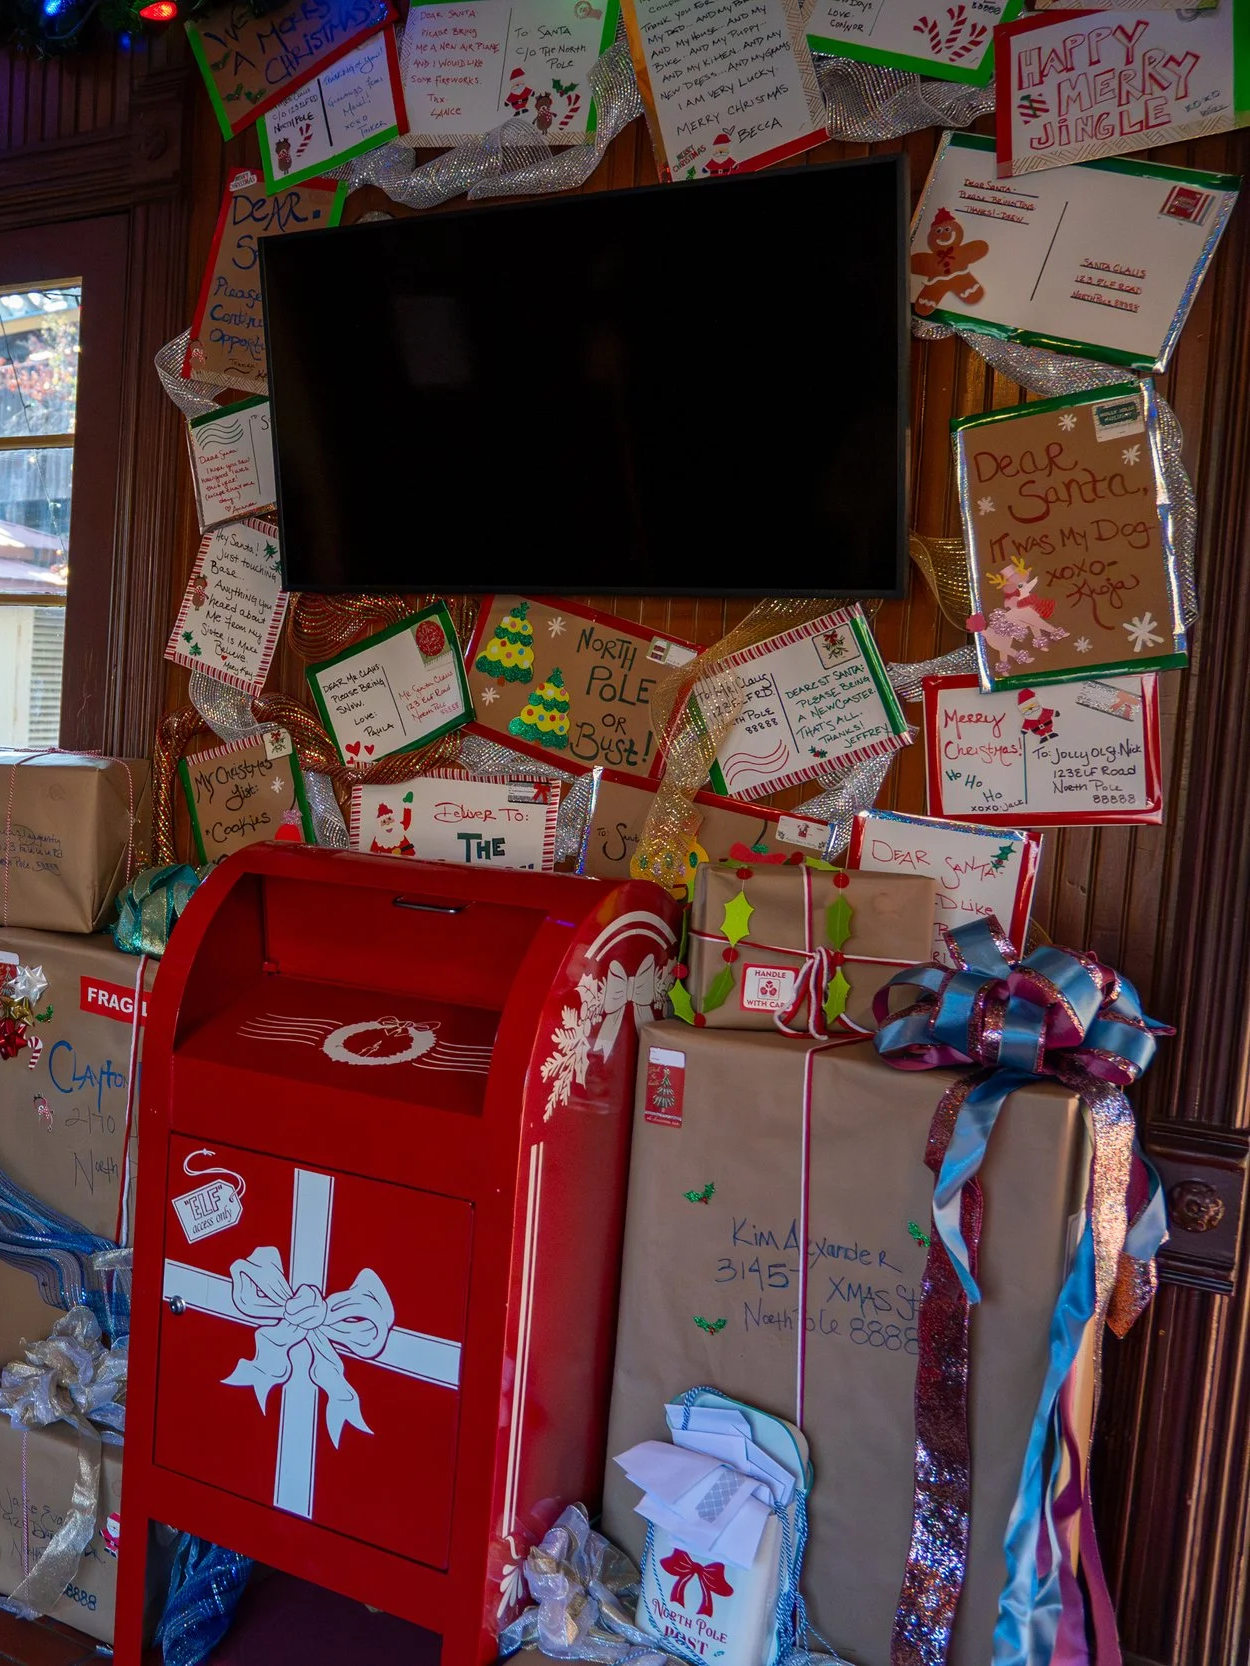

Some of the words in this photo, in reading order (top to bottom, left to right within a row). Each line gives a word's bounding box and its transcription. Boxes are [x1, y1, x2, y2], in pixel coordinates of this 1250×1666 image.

[537, 25, 572, 40] SANTA
[650, 46, 671, 60] AND
[726, 12, 748, 27] AND
[830, 18, 864, 33] CONNOR
[662, 69, 684, 84] AND
[743, 36, 764, 50] AND
[689, 44, 710, 56] AND
[1017, 20, 1150, 91] HAPPY
[546, 59, 575, 70] POLE
[660, 86, 681, 101] NEW
[727, 60, 750, 73] AND
[1057, 48, 1201, 118] MERRY
[685, 95, 706, 107] AM
[707, 83, 735, 100] VERY
[726, 84, 789, 116] CHRISTMAS
[676, 111, 721, 137] MERRY
[736, 117, 783, 144] BECCA
[215, 529, 229, 546] Hey
[989, 531, 1010, 564] IT
[1011, 534, 1056, 556] WAS
[1090, 518, 1157, 550] Dog
[216, 548, 239, 563] Just
[239, 608, 267, 626] about
[575, 626, 638, 672] NORTH
[322, 677, 348, 694] DEAR
[359, 663, 382, 679] CLAUS
[584, 665, 657, 706] POLE
[784, 674, 831, 700] DEAREST
[405, 699, 421, 713] 123
[795, 686, 842, 709] PLEASE
[746, 706, 775, 722] POLE
[810, 700, 837, 720] NEW
[363, 721, 395, 738] PAULA
[600, 713, 626, 735] OR
[745, 716, 780, 735] 88888
[796, 718, 837, 740] THAT'S
[817, 719, 865, 744] THANKS!
[843, 722, 890, 749] JEFFREY
[1119, 738, 1143, 757] Nick
[945, 768, 962, 782] Ho
[964, 773, 984, 789] Ho
[1052, 767, 1075, 779] 123
[1101, 764, 1137, 777] Road
[982, 789, 1003, 803] Ho
[1091, 793, 1137, 806] 88888
[456, 831, 506, 864] THE
[871, 839, 931, 870] DEAR
[755, 969, 787, 979] HANDLE
[747, 999, 768, 1007] WITH
[193, 1217, 214, 1235] access
[215, 1204, 232, 1224] only
[651, 1597, 693, 1631] NORTH
[695, 1617, 729, 1645] POLE
[663, 1624, 710, 1656] POST
